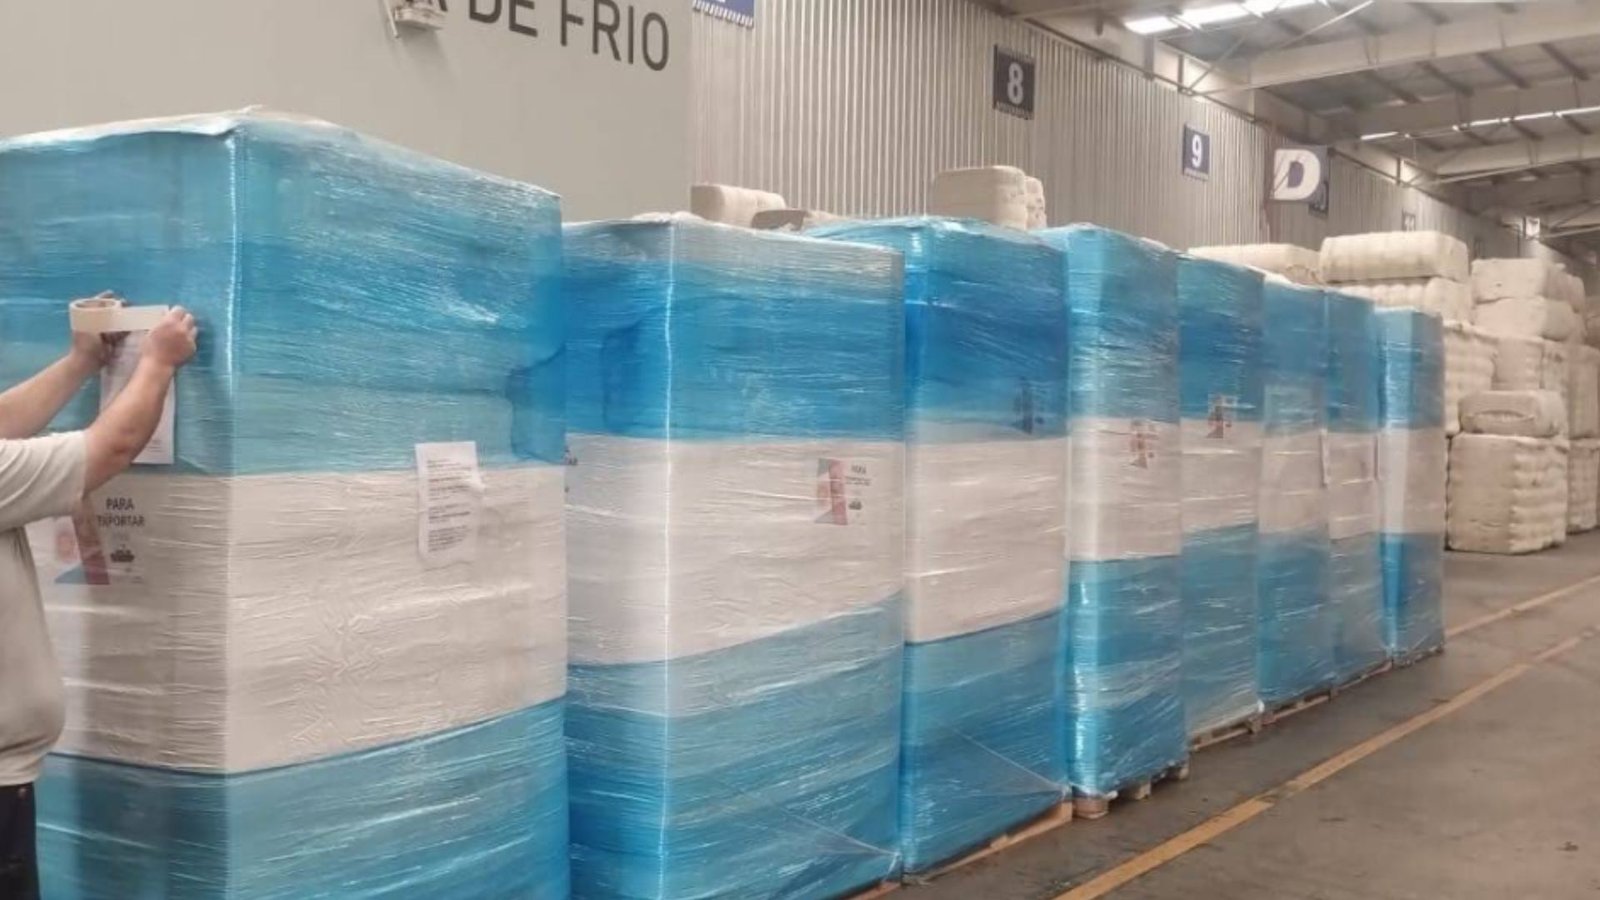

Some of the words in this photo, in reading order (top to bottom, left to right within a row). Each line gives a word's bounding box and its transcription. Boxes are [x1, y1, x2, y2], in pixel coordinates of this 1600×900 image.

[559, 0, 669, 71] FRIO
[1007, 62, 1024, 105] 8
[1192, 134, 1202, 168] 9
[1273, 149, 1321, 201] D
[105, 498, 135, 511] PARA
